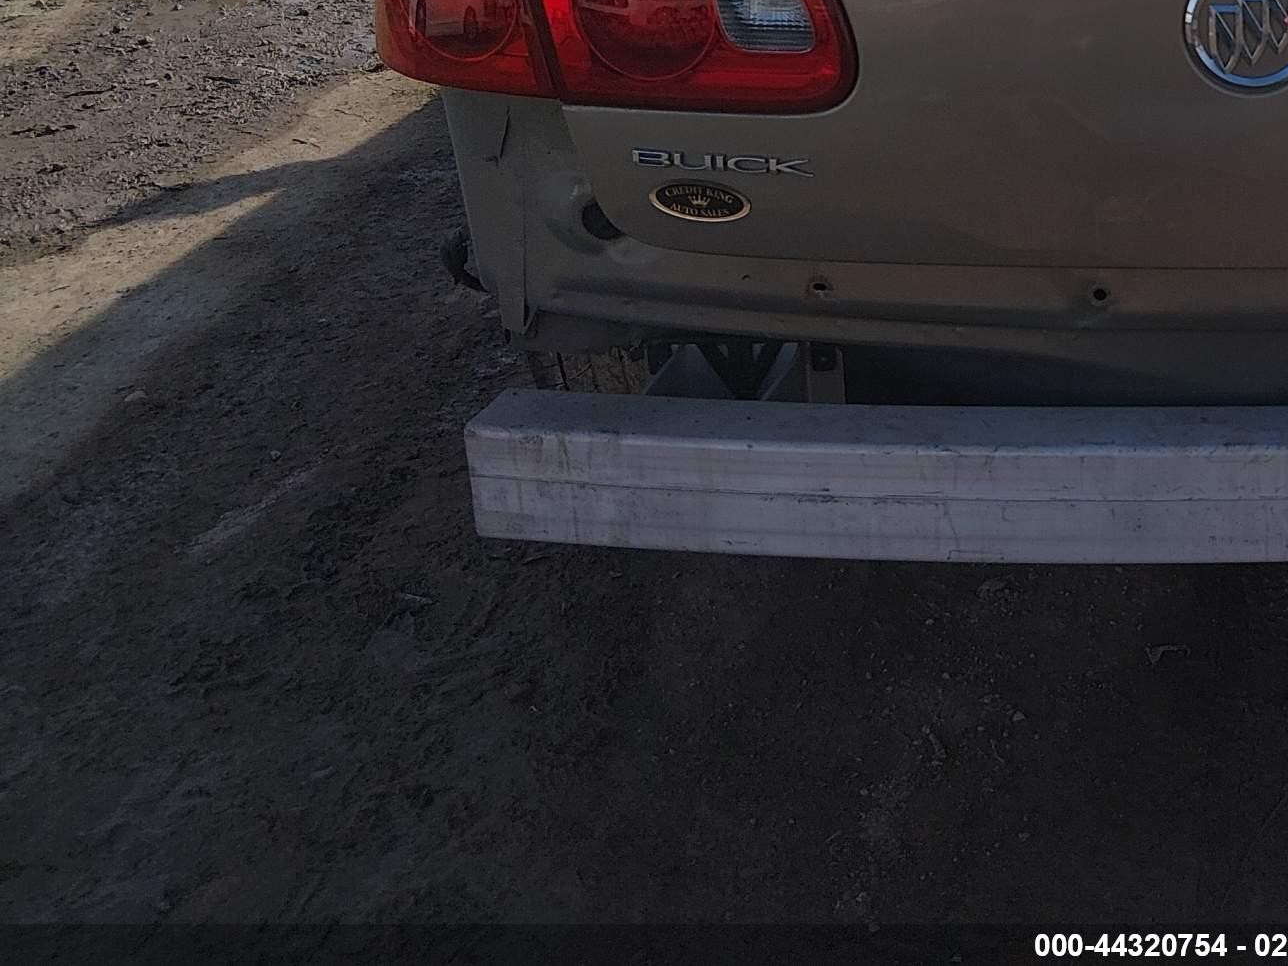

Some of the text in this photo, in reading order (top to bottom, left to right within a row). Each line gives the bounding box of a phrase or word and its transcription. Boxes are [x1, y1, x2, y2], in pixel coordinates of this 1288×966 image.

[631, 148, 815, 178] BUICK
[665, 185, 735, 204] CREDIT KING
[671, 202, 730, 217] AUTO SALES
